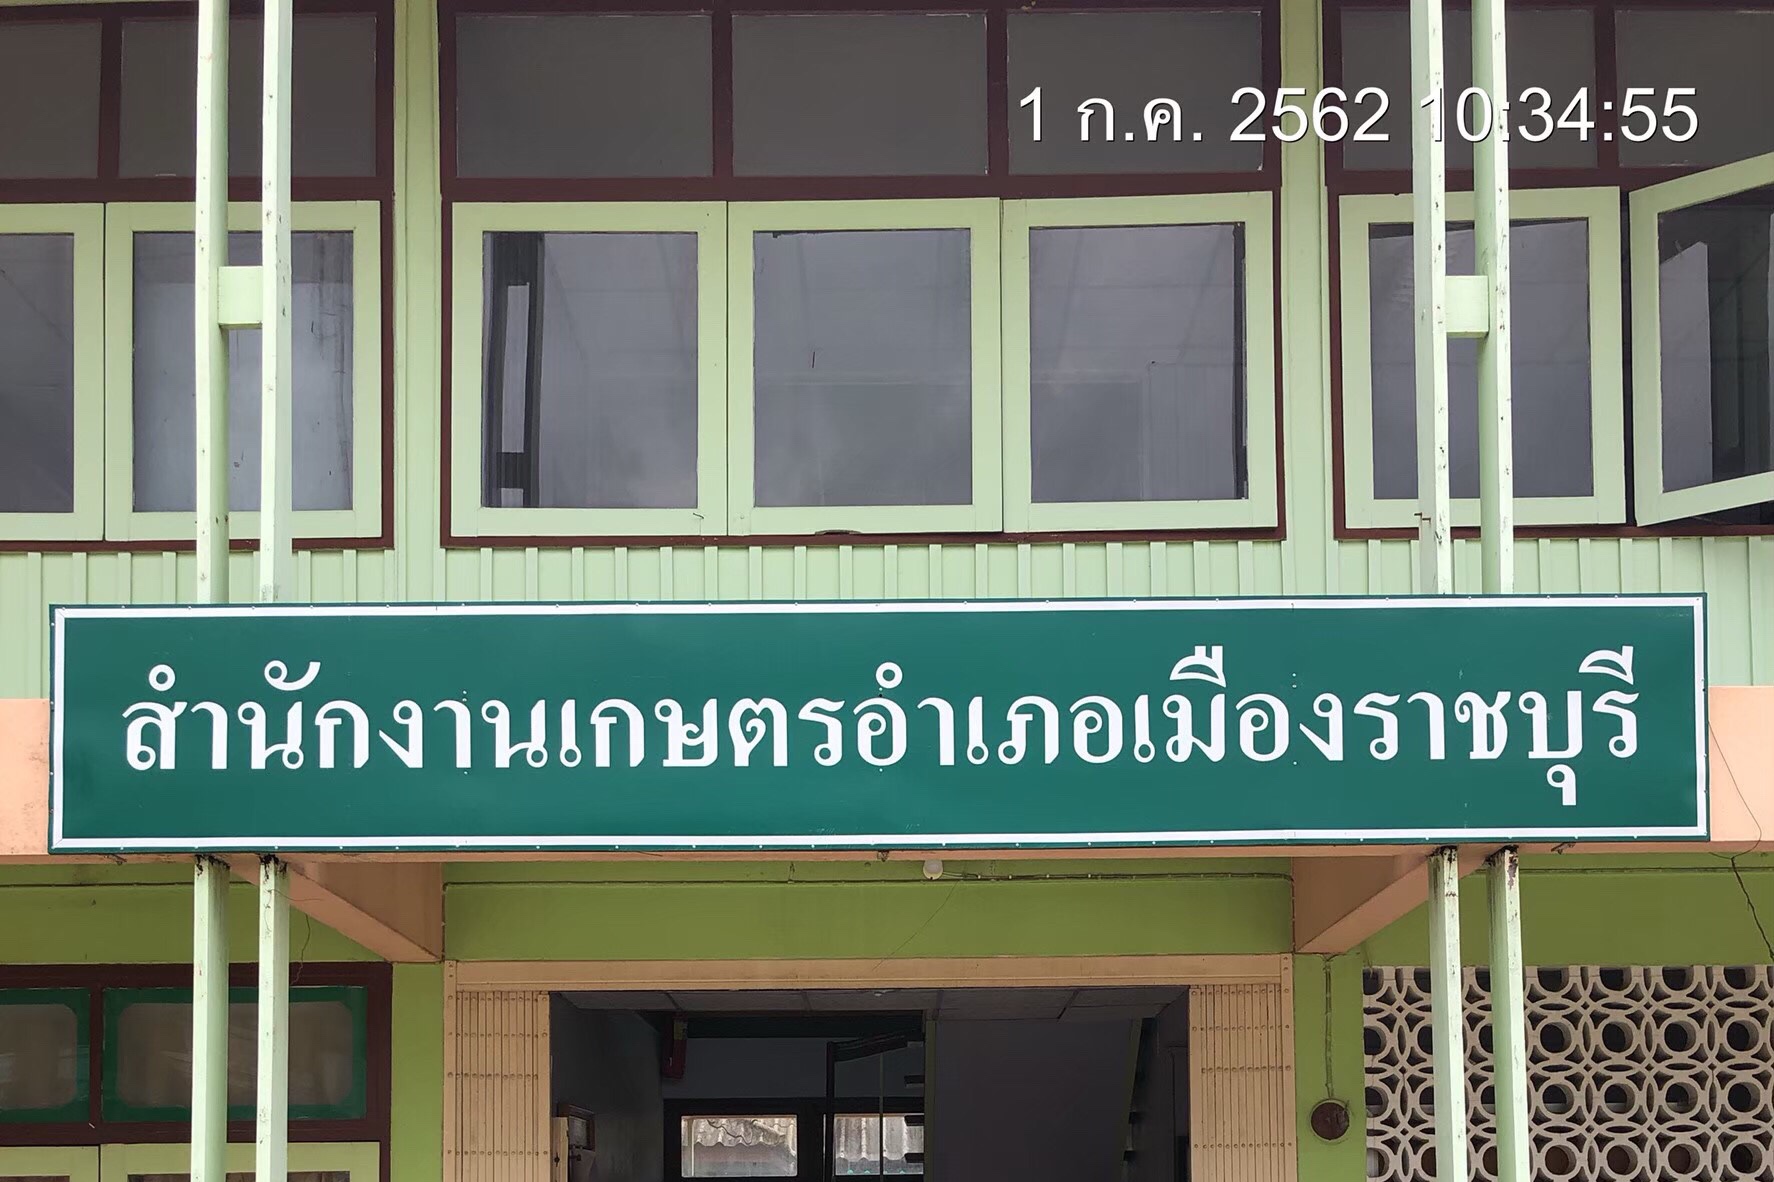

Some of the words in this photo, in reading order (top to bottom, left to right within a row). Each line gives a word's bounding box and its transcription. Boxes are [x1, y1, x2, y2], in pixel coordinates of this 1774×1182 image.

[121, 645, 1640, 806] สำนักงานเกษตรอำเภอเมืองราชบุรี
